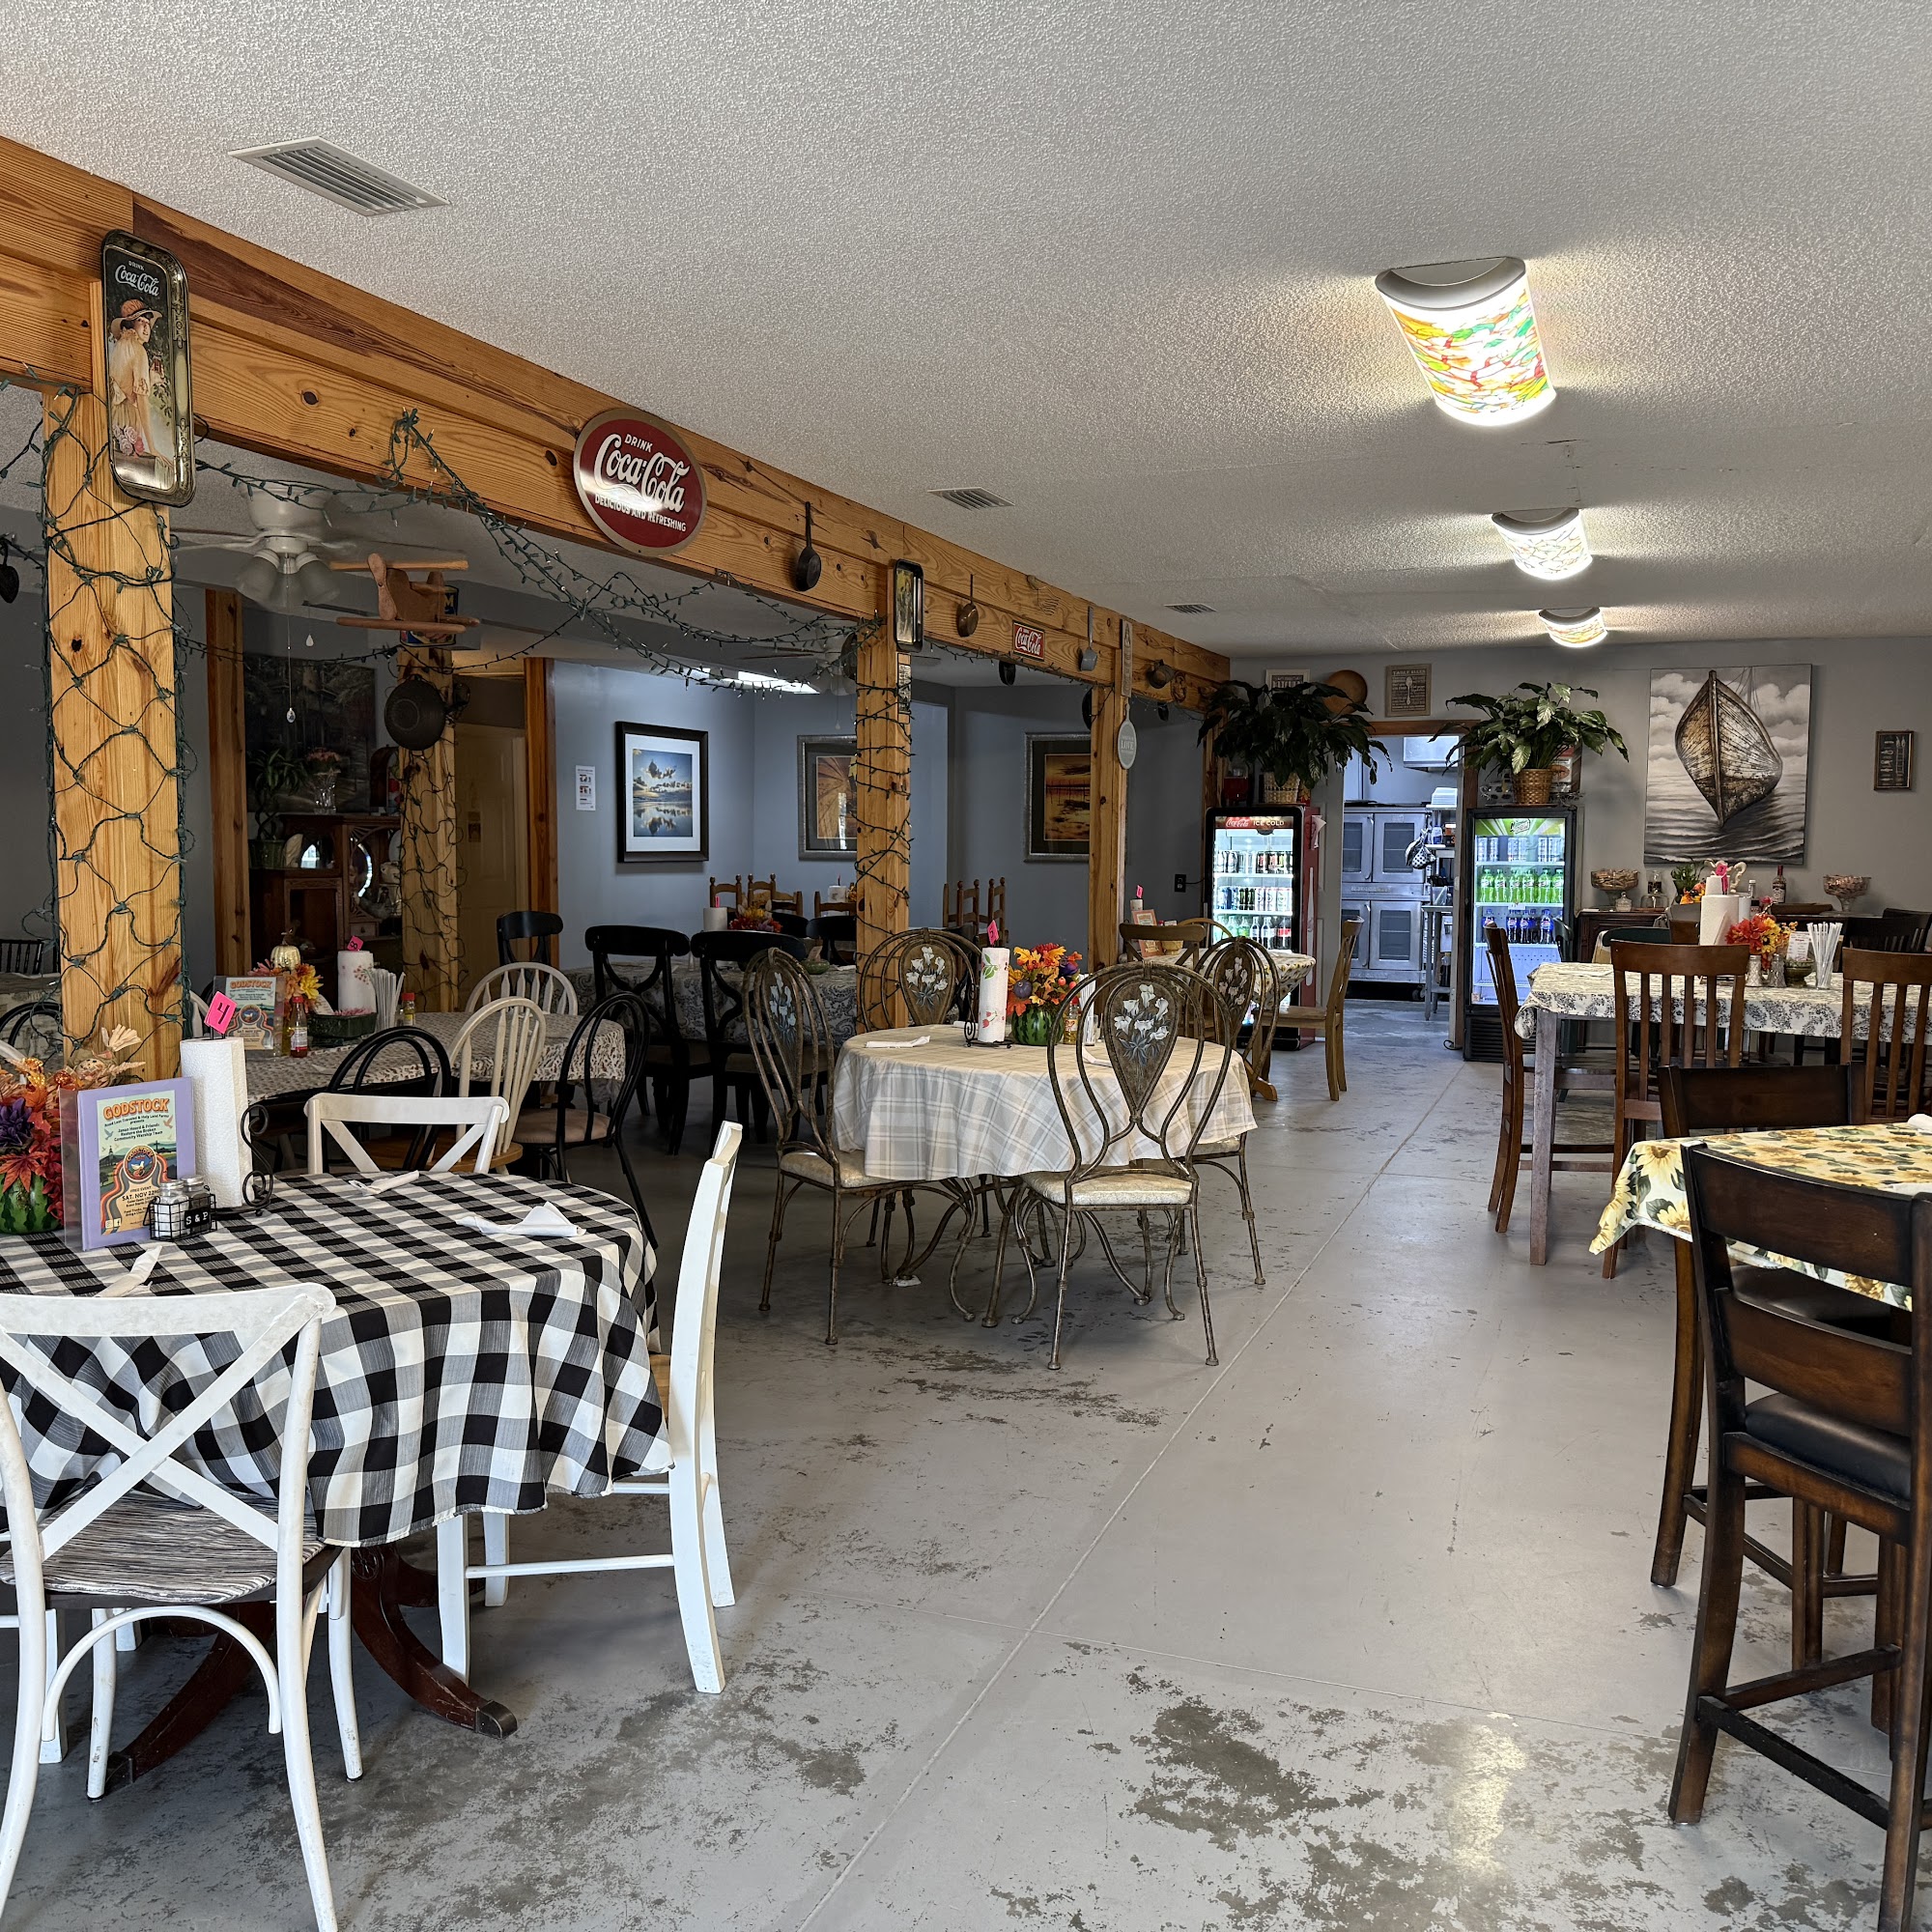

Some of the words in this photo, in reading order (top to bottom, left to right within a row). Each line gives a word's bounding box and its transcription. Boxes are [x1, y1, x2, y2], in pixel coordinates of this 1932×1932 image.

[128, 261, 144, 270] DRINK
[115, 265, 159, 296] Coca-Cola
[624, 434, 653, 453] DRINK
[593, 434, 690, 513] Coca-Cola
[595, 494, 631, 515] DELICIOUS
[631, 508, 646, 520] AND
[647, 512, 687, 532] REFRESHING
[1015, 627, 1041, 655] Coca-Cola
[1226, 818, 1250, 828] Coca-Cola
[217, 1003, 231, 1025] 4
[103, 1098, 170, 1121] GODSTOCK
[185, 1215, 192, 1225] S
[195, 1214, 200, 1223] &
[203, 1211, 209, 1221] P
